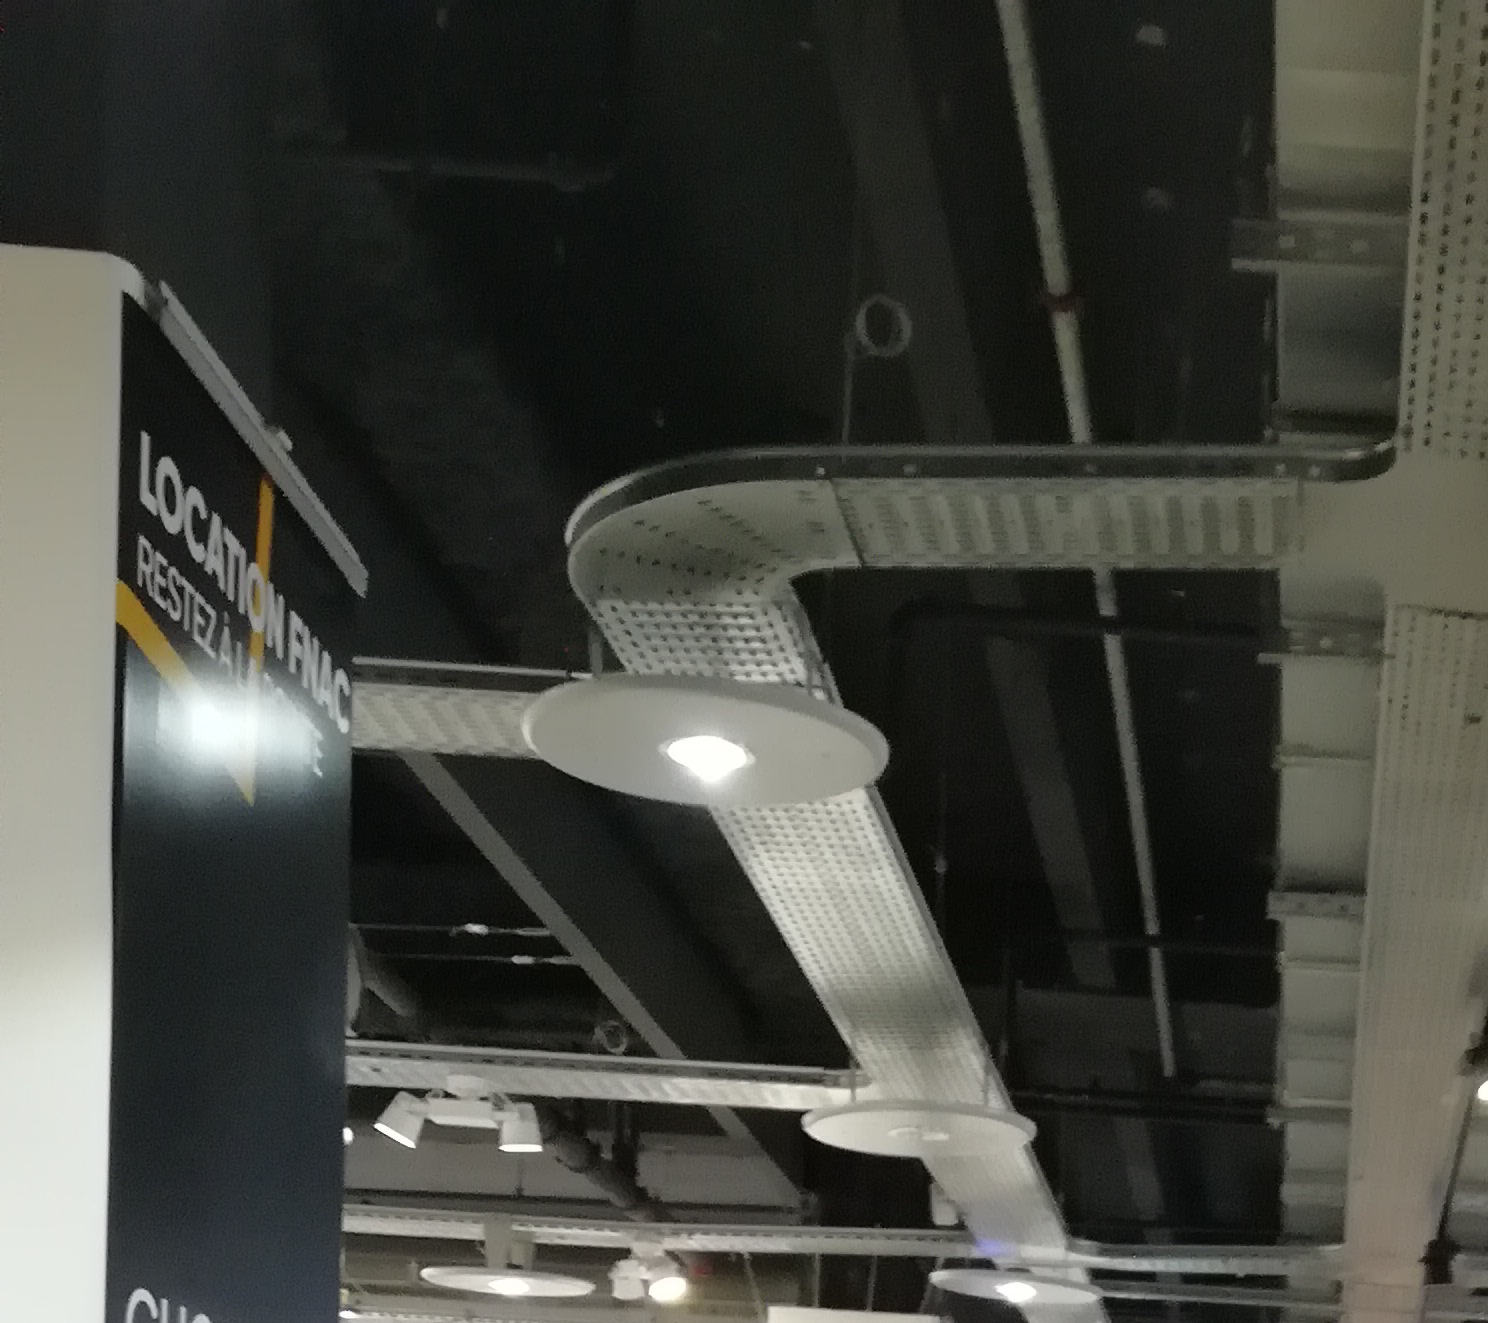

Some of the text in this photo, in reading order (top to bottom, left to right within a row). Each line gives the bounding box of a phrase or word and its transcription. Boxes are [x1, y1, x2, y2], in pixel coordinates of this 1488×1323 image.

[136, 532, 217, 660] RESTEZ
[140, 430, 286, 661] LOCATION
[288, 609, 350, 734] FNAC
